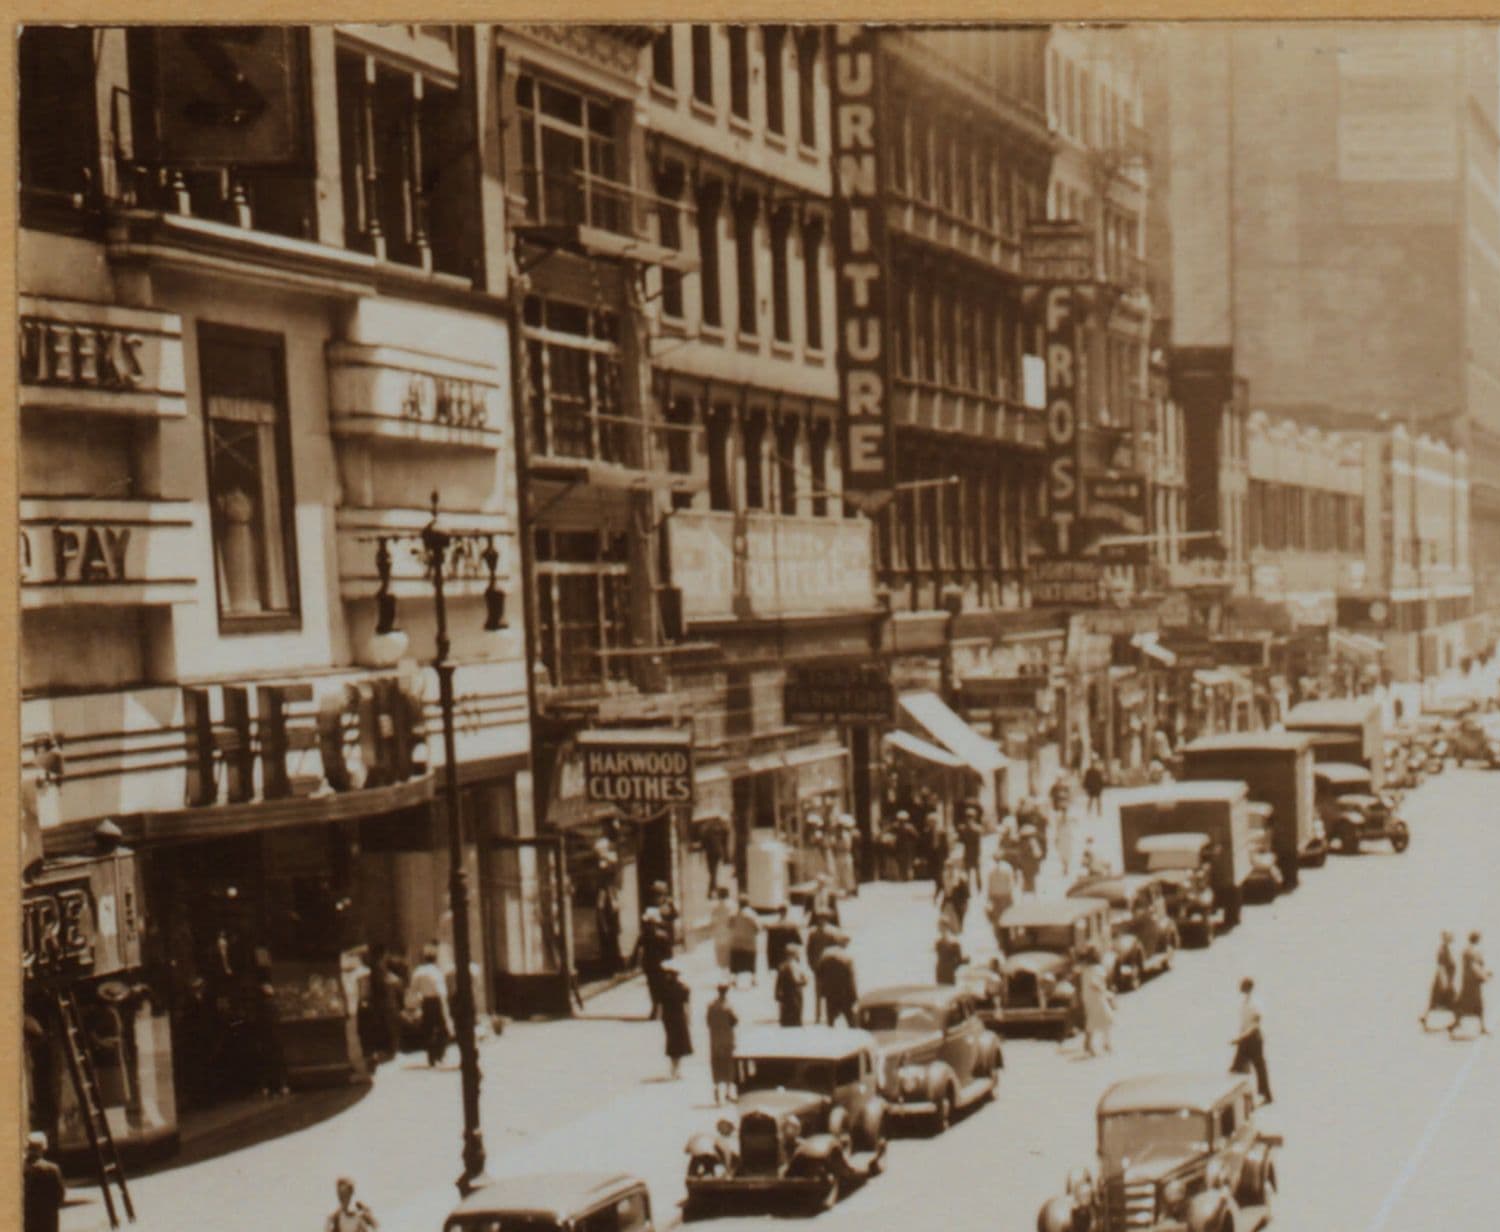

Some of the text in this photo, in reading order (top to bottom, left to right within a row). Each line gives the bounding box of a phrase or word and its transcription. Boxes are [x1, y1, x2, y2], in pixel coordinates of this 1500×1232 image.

[1046, 286, 1076, 553] FROST
[52, 525, 131, 581] PAY
[589, 751, 688, 774] HARWOOD
[589, 775, 691, 800] CLOTHES
